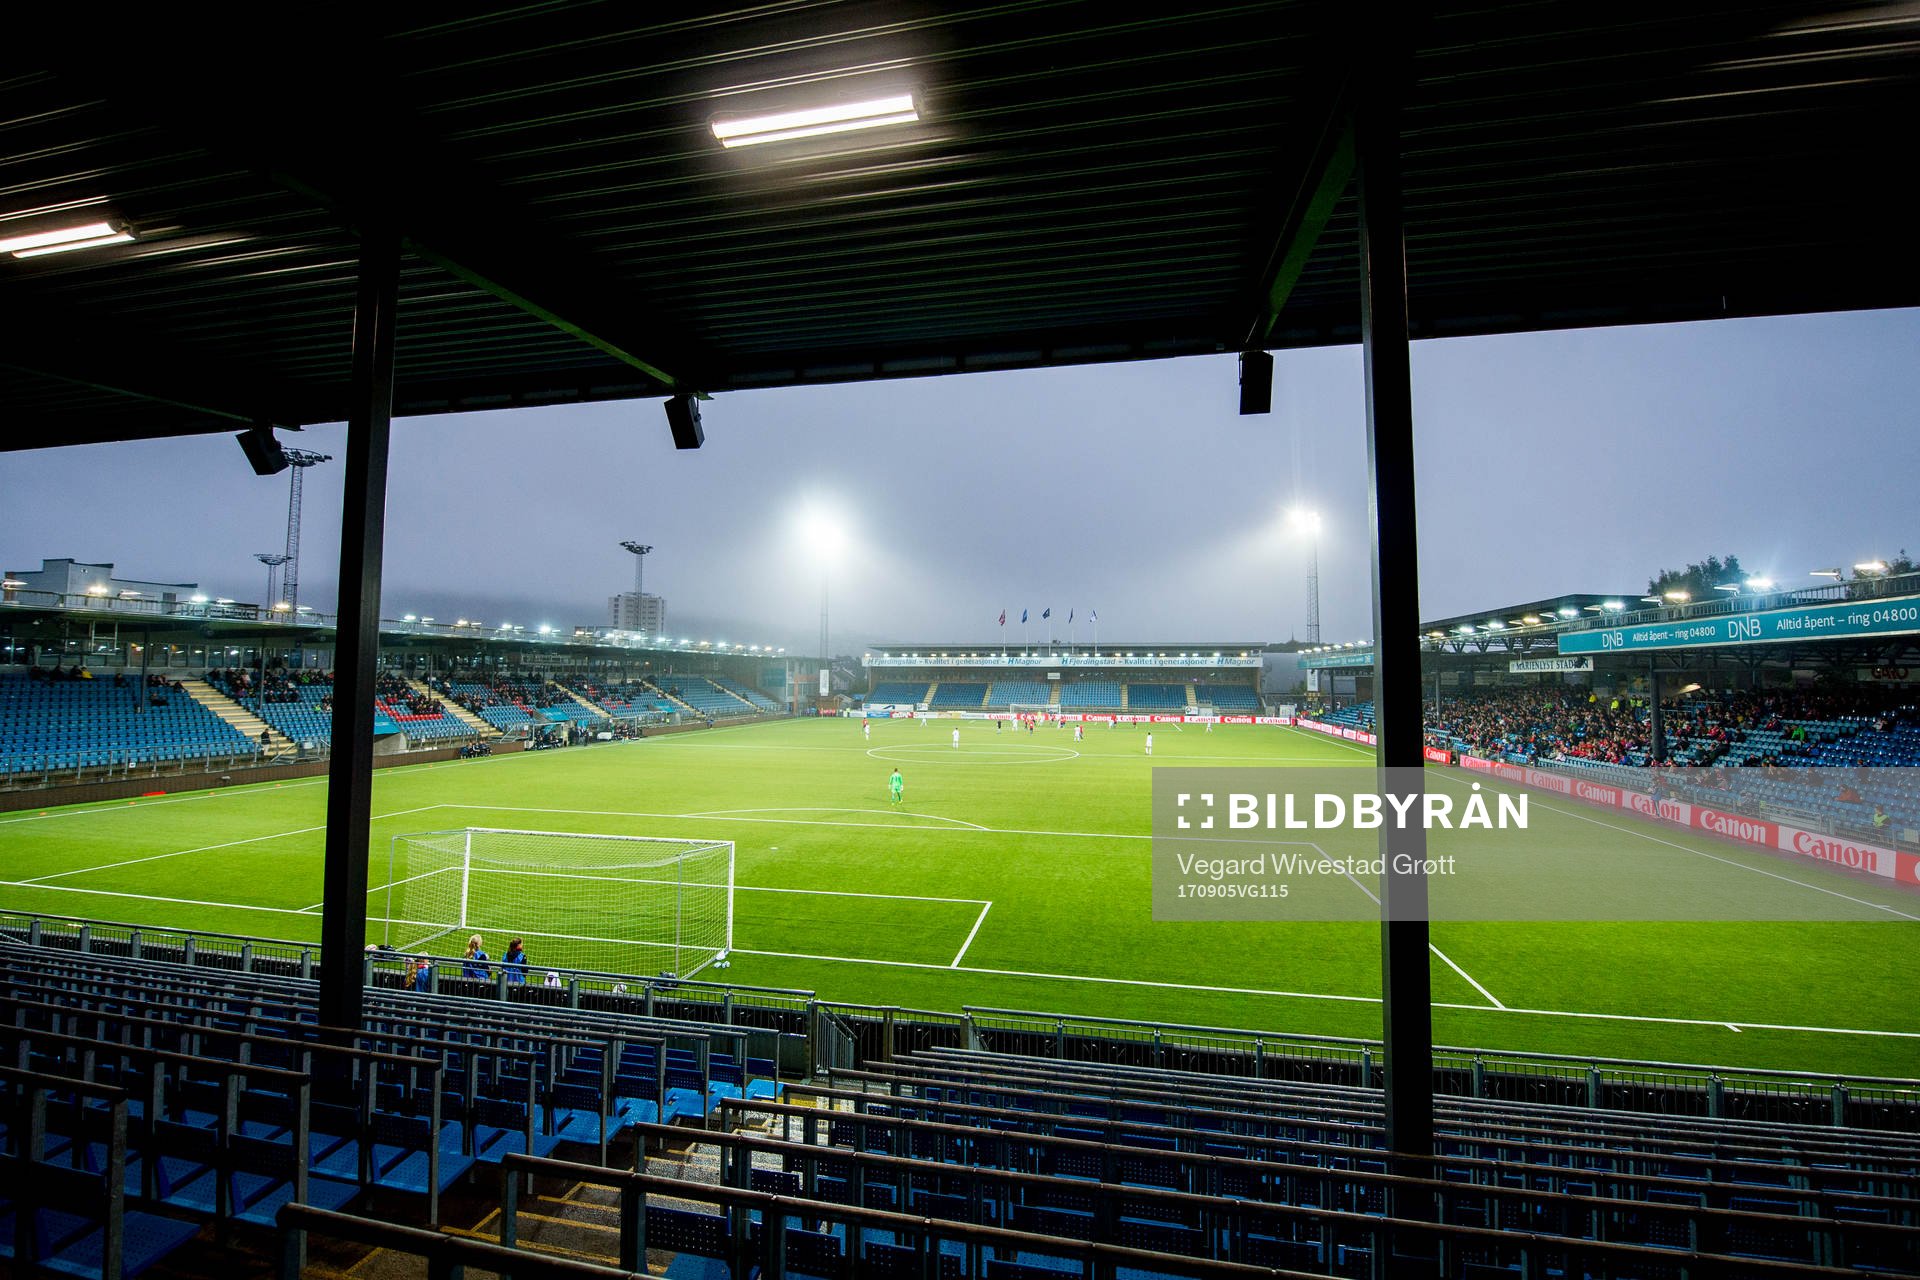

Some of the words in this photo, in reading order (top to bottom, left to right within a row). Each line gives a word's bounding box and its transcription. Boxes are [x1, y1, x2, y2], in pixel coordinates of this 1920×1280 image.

[1728, 616, 1761, 641] DNB
[1776, 618, 1801, 631] Alltid
[1804, 615, 1835, 631] åpent
[1848, 612, 1870, 627] ring
[1873, 607, 1917, 623] 04800
[1602, 630, 1623, 650] DNB
[1632, 632, 1649, 642] Alltid
[1649, 630, 1668, 642] åpent
[1675, 630, 1688, 640] ring
[1690, 626, 1716, 637] 04800
[1069, 658, 1115, 666] Fjerdingstad
[1158, 658, 1207, 666] generasjoner
[1425, 748, 1446, 761] Canon
[1495, 763, 1522, 780] Canon
[1531, 770, 1565, 791] Canon
[1576, 781, 1616, 805] Canon
[1700, 810, 1766, 843] Canon
[1793, 831, 1877, 872] Canon
